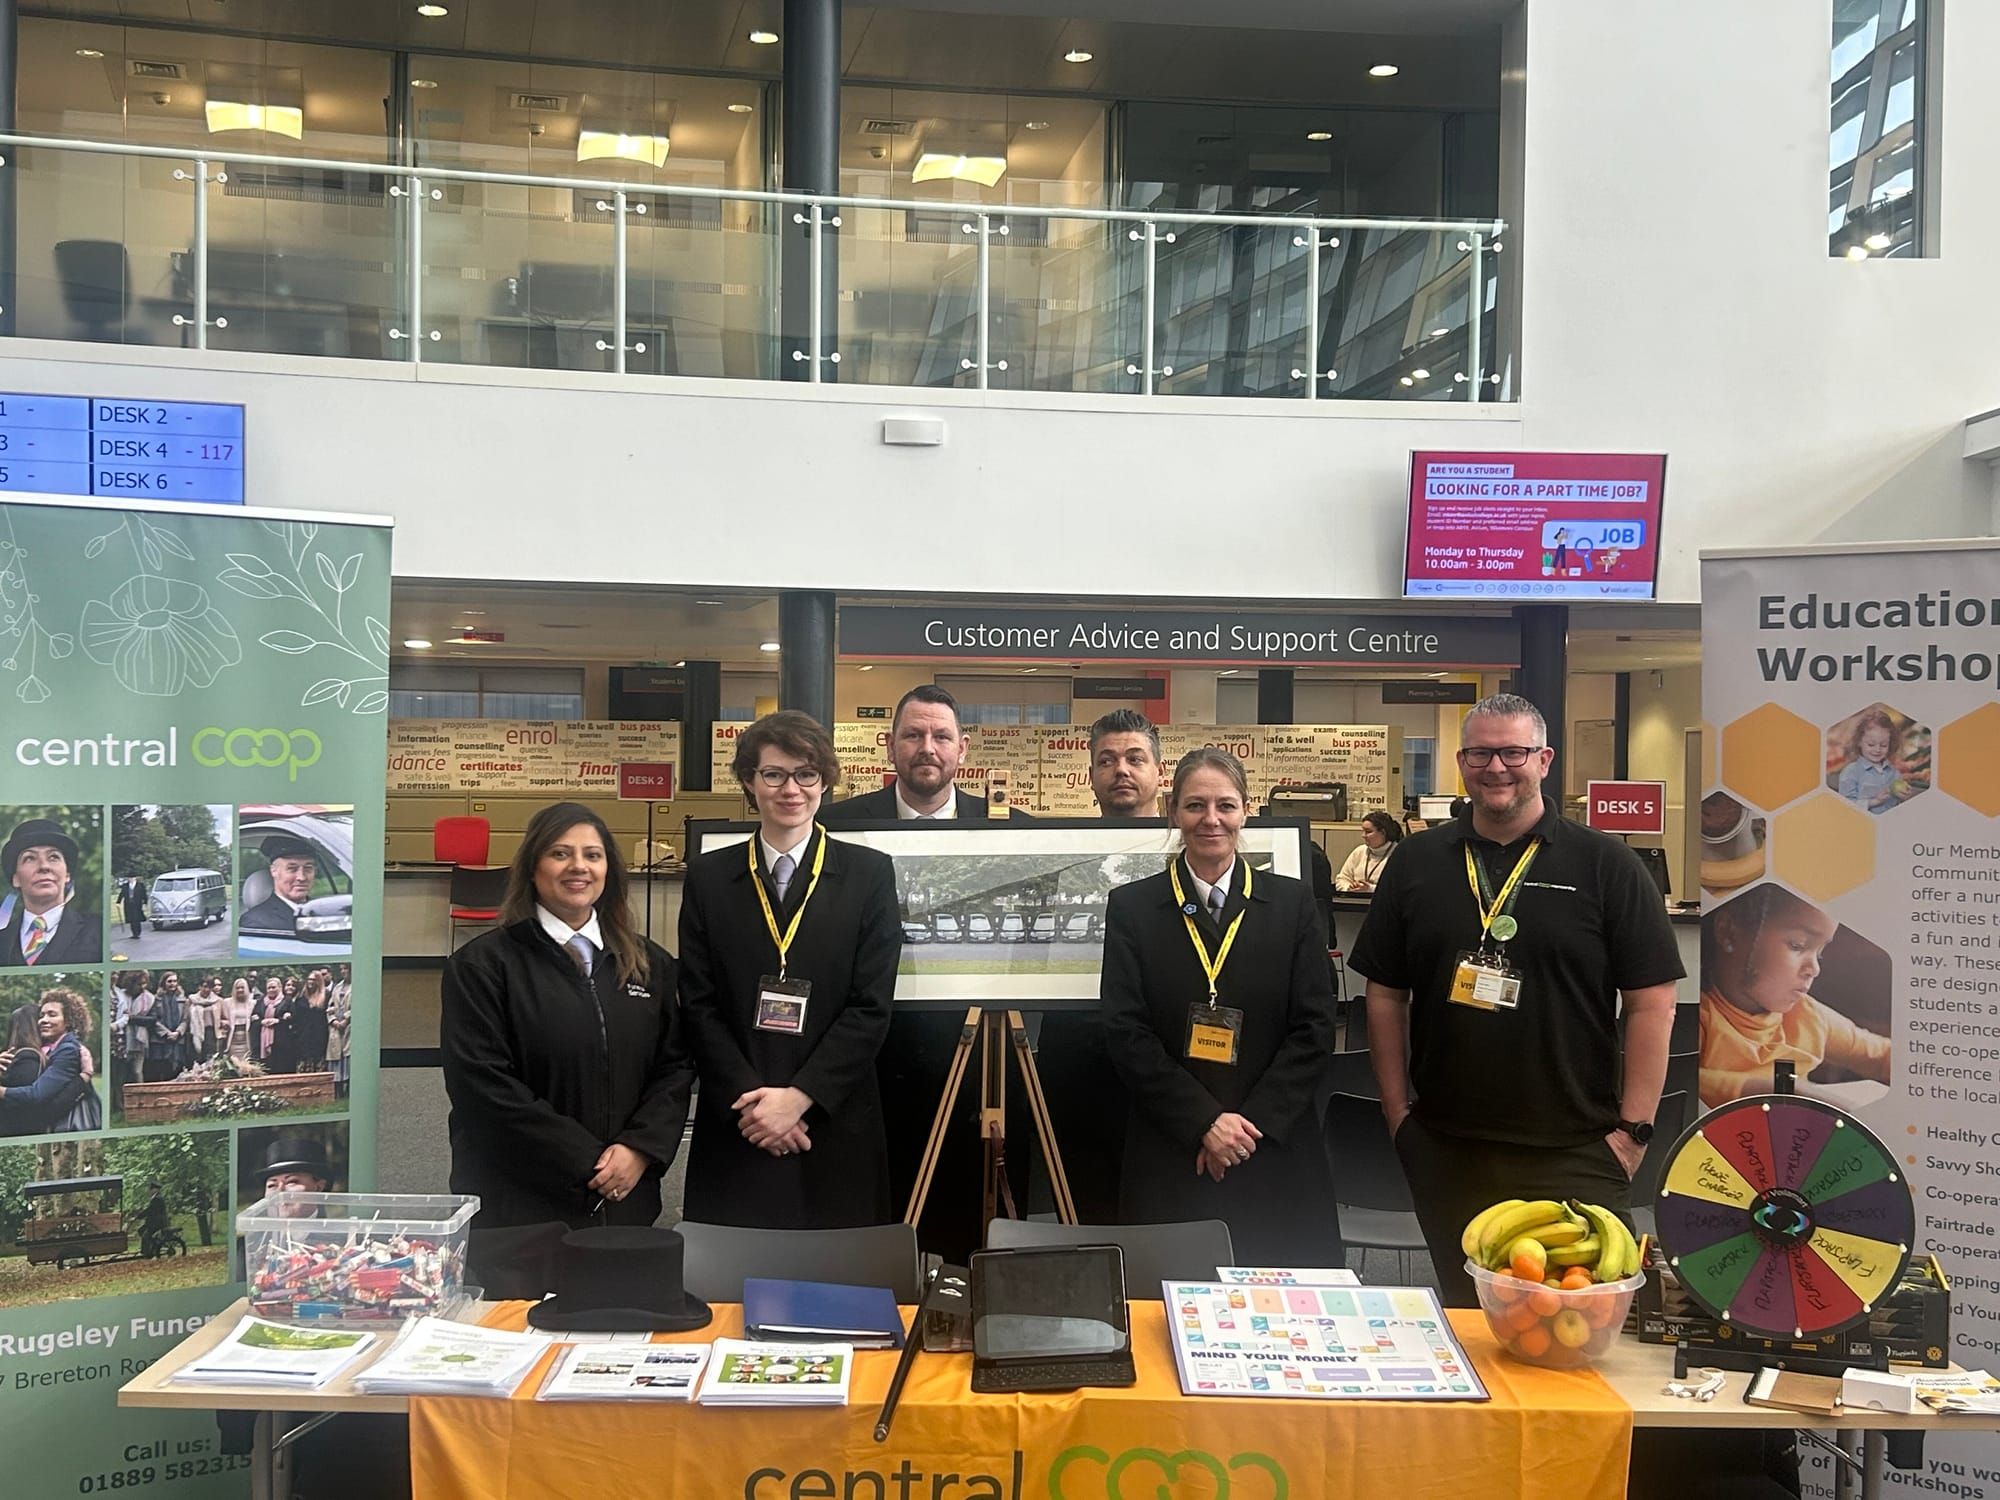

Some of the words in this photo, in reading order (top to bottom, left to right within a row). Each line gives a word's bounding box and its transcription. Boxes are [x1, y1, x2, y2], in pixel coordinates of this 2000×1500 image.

[100, 406, 150, 423] DESK
[156, 408, 168, 424] 2
[100, 440, 150, 457] DESK
[156, 442, 168, 459] 4
[201, 444, 233, 461] 117
[1430, 466, 1447, 474] ARE
[1449, 466, 1465, 474] YOU
[1474, 467, 1510, 475] STUDENT
[100, 471, 150, 489] DESK
[156, 474, 168, 490] 6
[1429, 483, 1489, 496] LOOKING
[1493, 484, 1520, 496] FOR
[1523, 484, 1533, 496] A
[1537, 484, 1573, 497] PART
[1577, 485, 1608, 497] TIME
[1611, 485, 1642, 499] JOB?
[1600, 528, 1634, 544] JOB
[1425, 546, 1464, 558] Monday
[1466, 547, 1476, 557] to
[1478, 547, 1524, 560] Thursday
[1425, 559, 1468, 569] 10.00am
[1476, 559, 1514, 571] 3.00pm
[925, 620, 1060, 647] Customer
[1068, 622, 1160, 649] Advice
[1170, 624, 1219, 650] and
[1231, 625, 1338, 657] Support
[1349, 628, 1438, 653] Centre
[1757, 645, 2000, 690] Worksho
[506, 726, 558, 745] enrol
[620, 723, 637, 731] bus
[640, 723, 661, 732] pass
[981, 728, 998, 737] bus
[1000, 728, 1020, 738] pass
[1341, 730, 1385, 738] counselling
[398, 735, 450, 743] information
[660, 732, 677, 740] trips
[1295, 736, 1315, 744] well
[1332, 738, 1351, 747] bus
[1353, 740, 1377, 749] pass
[16, 726, 176, 766] central
[455, 742, 505, 751] counselling
[386, 754, 446, 771] idance
[460, 762, 523, 771] certificates
[1274, 754, 1320, 763] information
[460, 779, 481, 787] trips
[529, 778, 563, 786] support
[584, 778, 615, 786] queries
[628, 776, 654, 785] DESK
[656, 776, 664, 785] 2
[1016, 781, 1034, 789] help
[1356, 773, 1381, 784] trips
[1597, 800, 1639, 814] DESK
[1644, 802, 1653, 814] 5
[1912, 843, 1944, 857] Our
[1912, 887, 1951, 901] offer
[1957, 891, 1966, 902] a
[1911, 910, 1986, 926] activities
[1911, 933, 1920, 944] a
[1927, 931, 1953, 945] fun
[1960, 935, 1991, 948] and
[1910, 955, 1948, 970] way.
[1954, 955, 2000, 971] These
[1910, 977, 1937, 989] are
[1943, 977, 2000, 995] design
[1910, 998, 1982, 1014] students
[1988, 1004, 1998, 1015] a
[1909, 1020, 2000, 1038] experience
[1197, 1037, 1226, 1049] VISITOR
[1909, 1040, 1936, 1054] the
[1908, 1062, 1992, 1081] difference
[1908, 1084, 1924, 1097] to
[1931, 1085, 1958, 1100] the
[1927, 1126, 1987, 1147] Healthy
[1926, 1156, 1971, 1176] Savvy
[1926, 1215, 1995, 1236] Fairtrade
[1812, 1233, 1877, 1279] FLAPJACK
[0, 1324, 120, 1356] Rugeley
[1191, 1352, 1237, 1360] MIND
[1243, 1352, 1289, 1361] YOUR
[1296, 1354, 1358, 1363] MONEY
[15, 1364, 110, 1390] Brereton
[124, 1440, 168, 1462] Call
[176, 1437, 211, 1453] us:
[1812, 1455, 1830, 1469] of
[1929, 1459, 1965, 1476] you
[79, 1467, 156, 1494] 01889
[165, 1454, 252, 1480] 582315
[746, 1450, 1022, 1500] central
